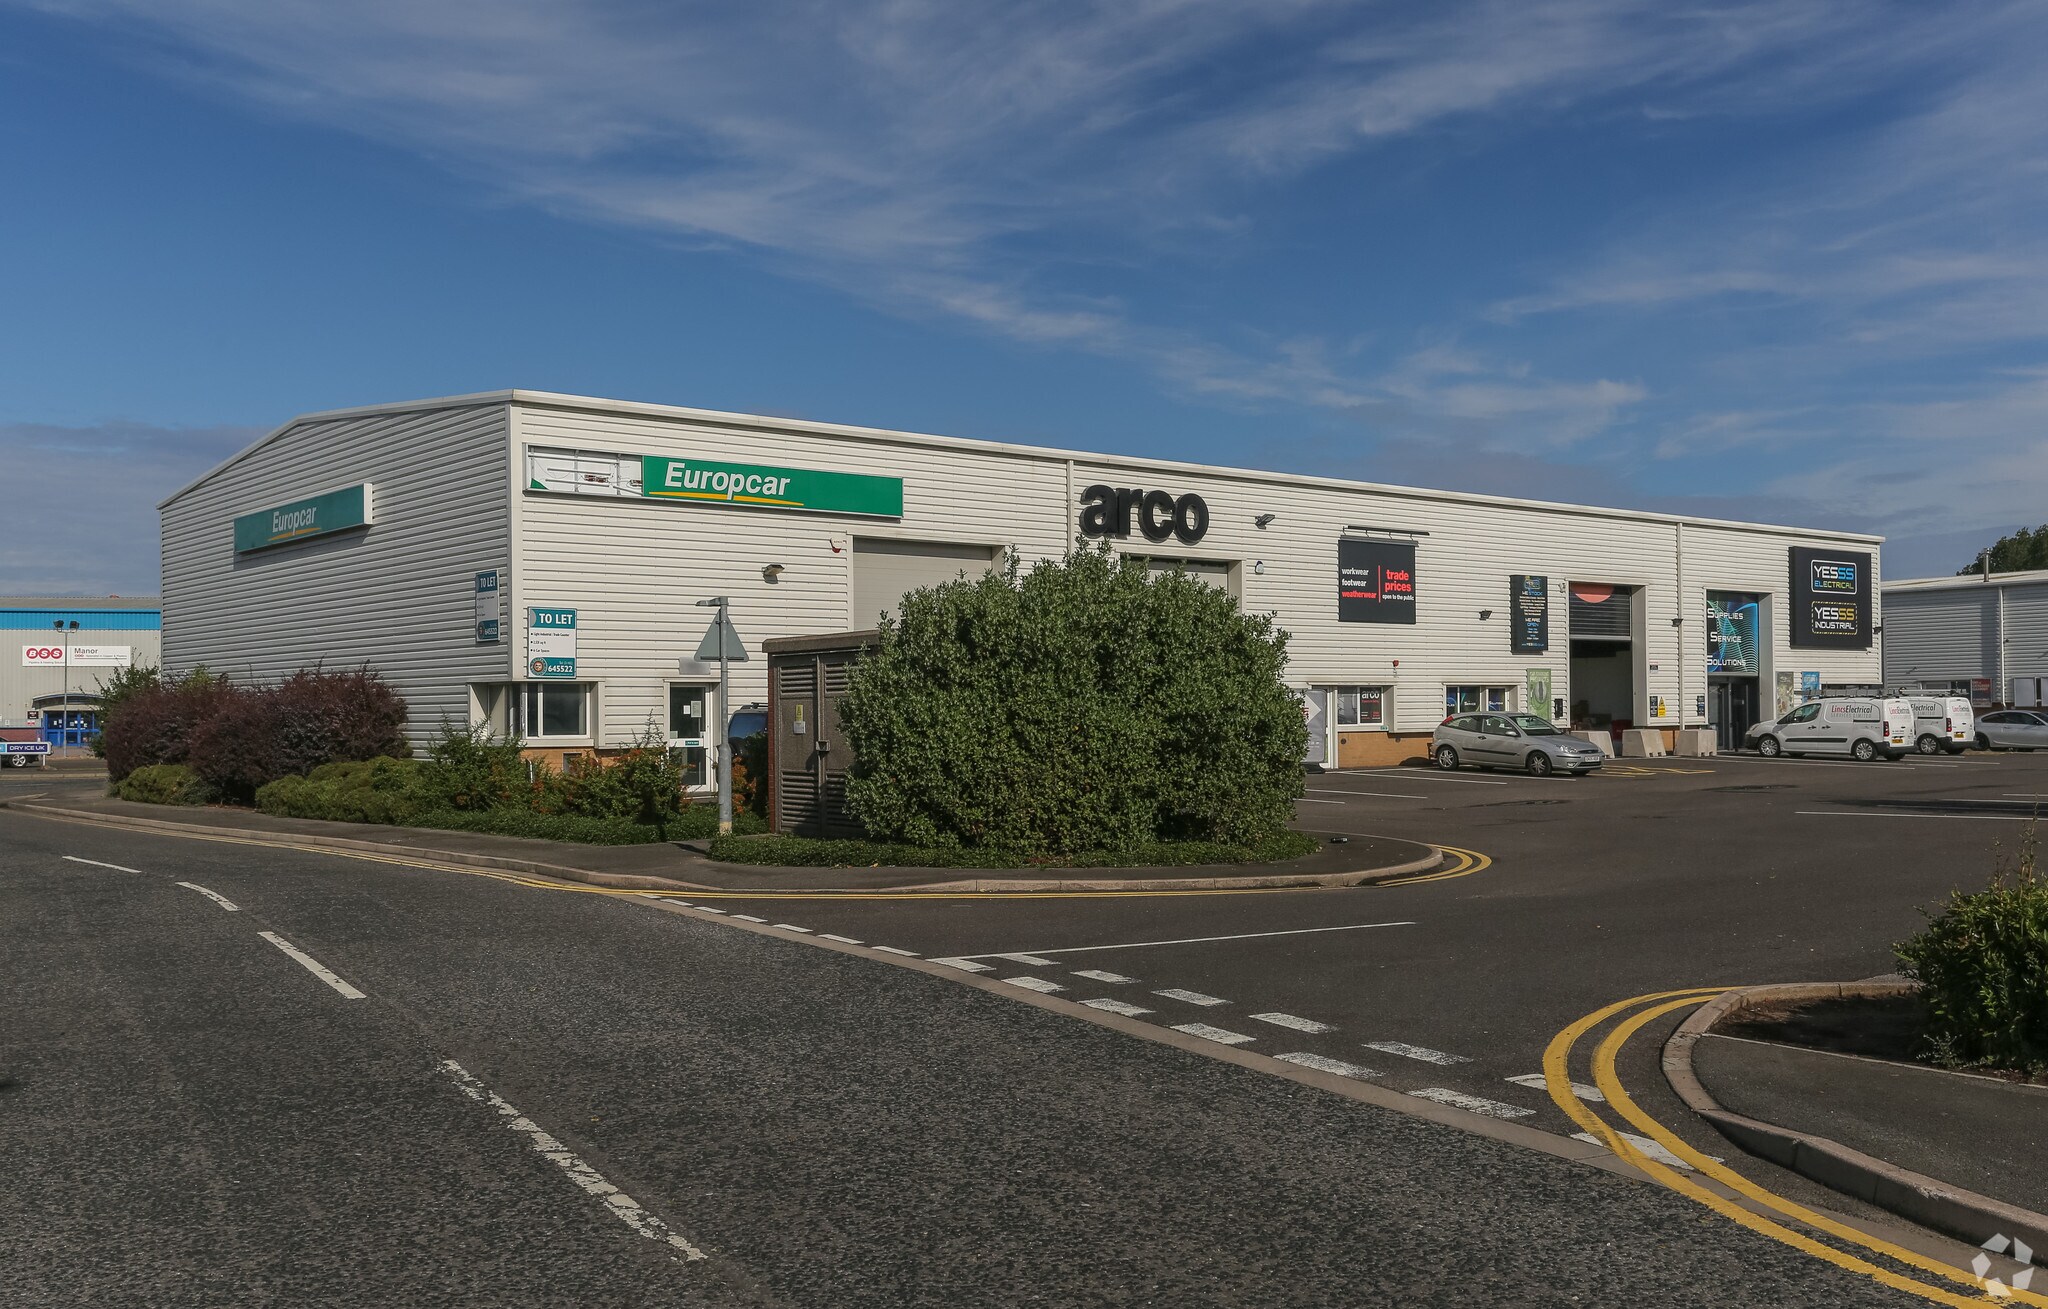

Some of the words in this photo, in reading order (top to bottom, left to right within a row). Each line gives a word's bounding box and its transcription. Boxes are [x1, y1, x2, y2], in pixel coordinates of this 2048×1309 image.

[664, 461, 791, 501] Europcar
[1079, 484, 1209, 546] arco
[272, 506, 317, 536] Europcar
[1386, 570, 1409, 580] trade
[1813, 565, 1855, 580] YESSS
[480, 577, 487, 588] TO
[486, 576, 496, 587] LET
[1384, 581, 1411, 592] prices
[1814, 580, 1854, 590] ELECTRICAL
[539, 613, 553, 624] TO
[555, 614, 573, 625] LET
[1814, 606, 1855, 621] YESSS
[1814, 621, 1855, 630] INDUSTRIAL
[27, 649, 61, 658] BSS
[1361, 690, 1380, 699] arco
[1910, 703, 1936, 712] Electrical
